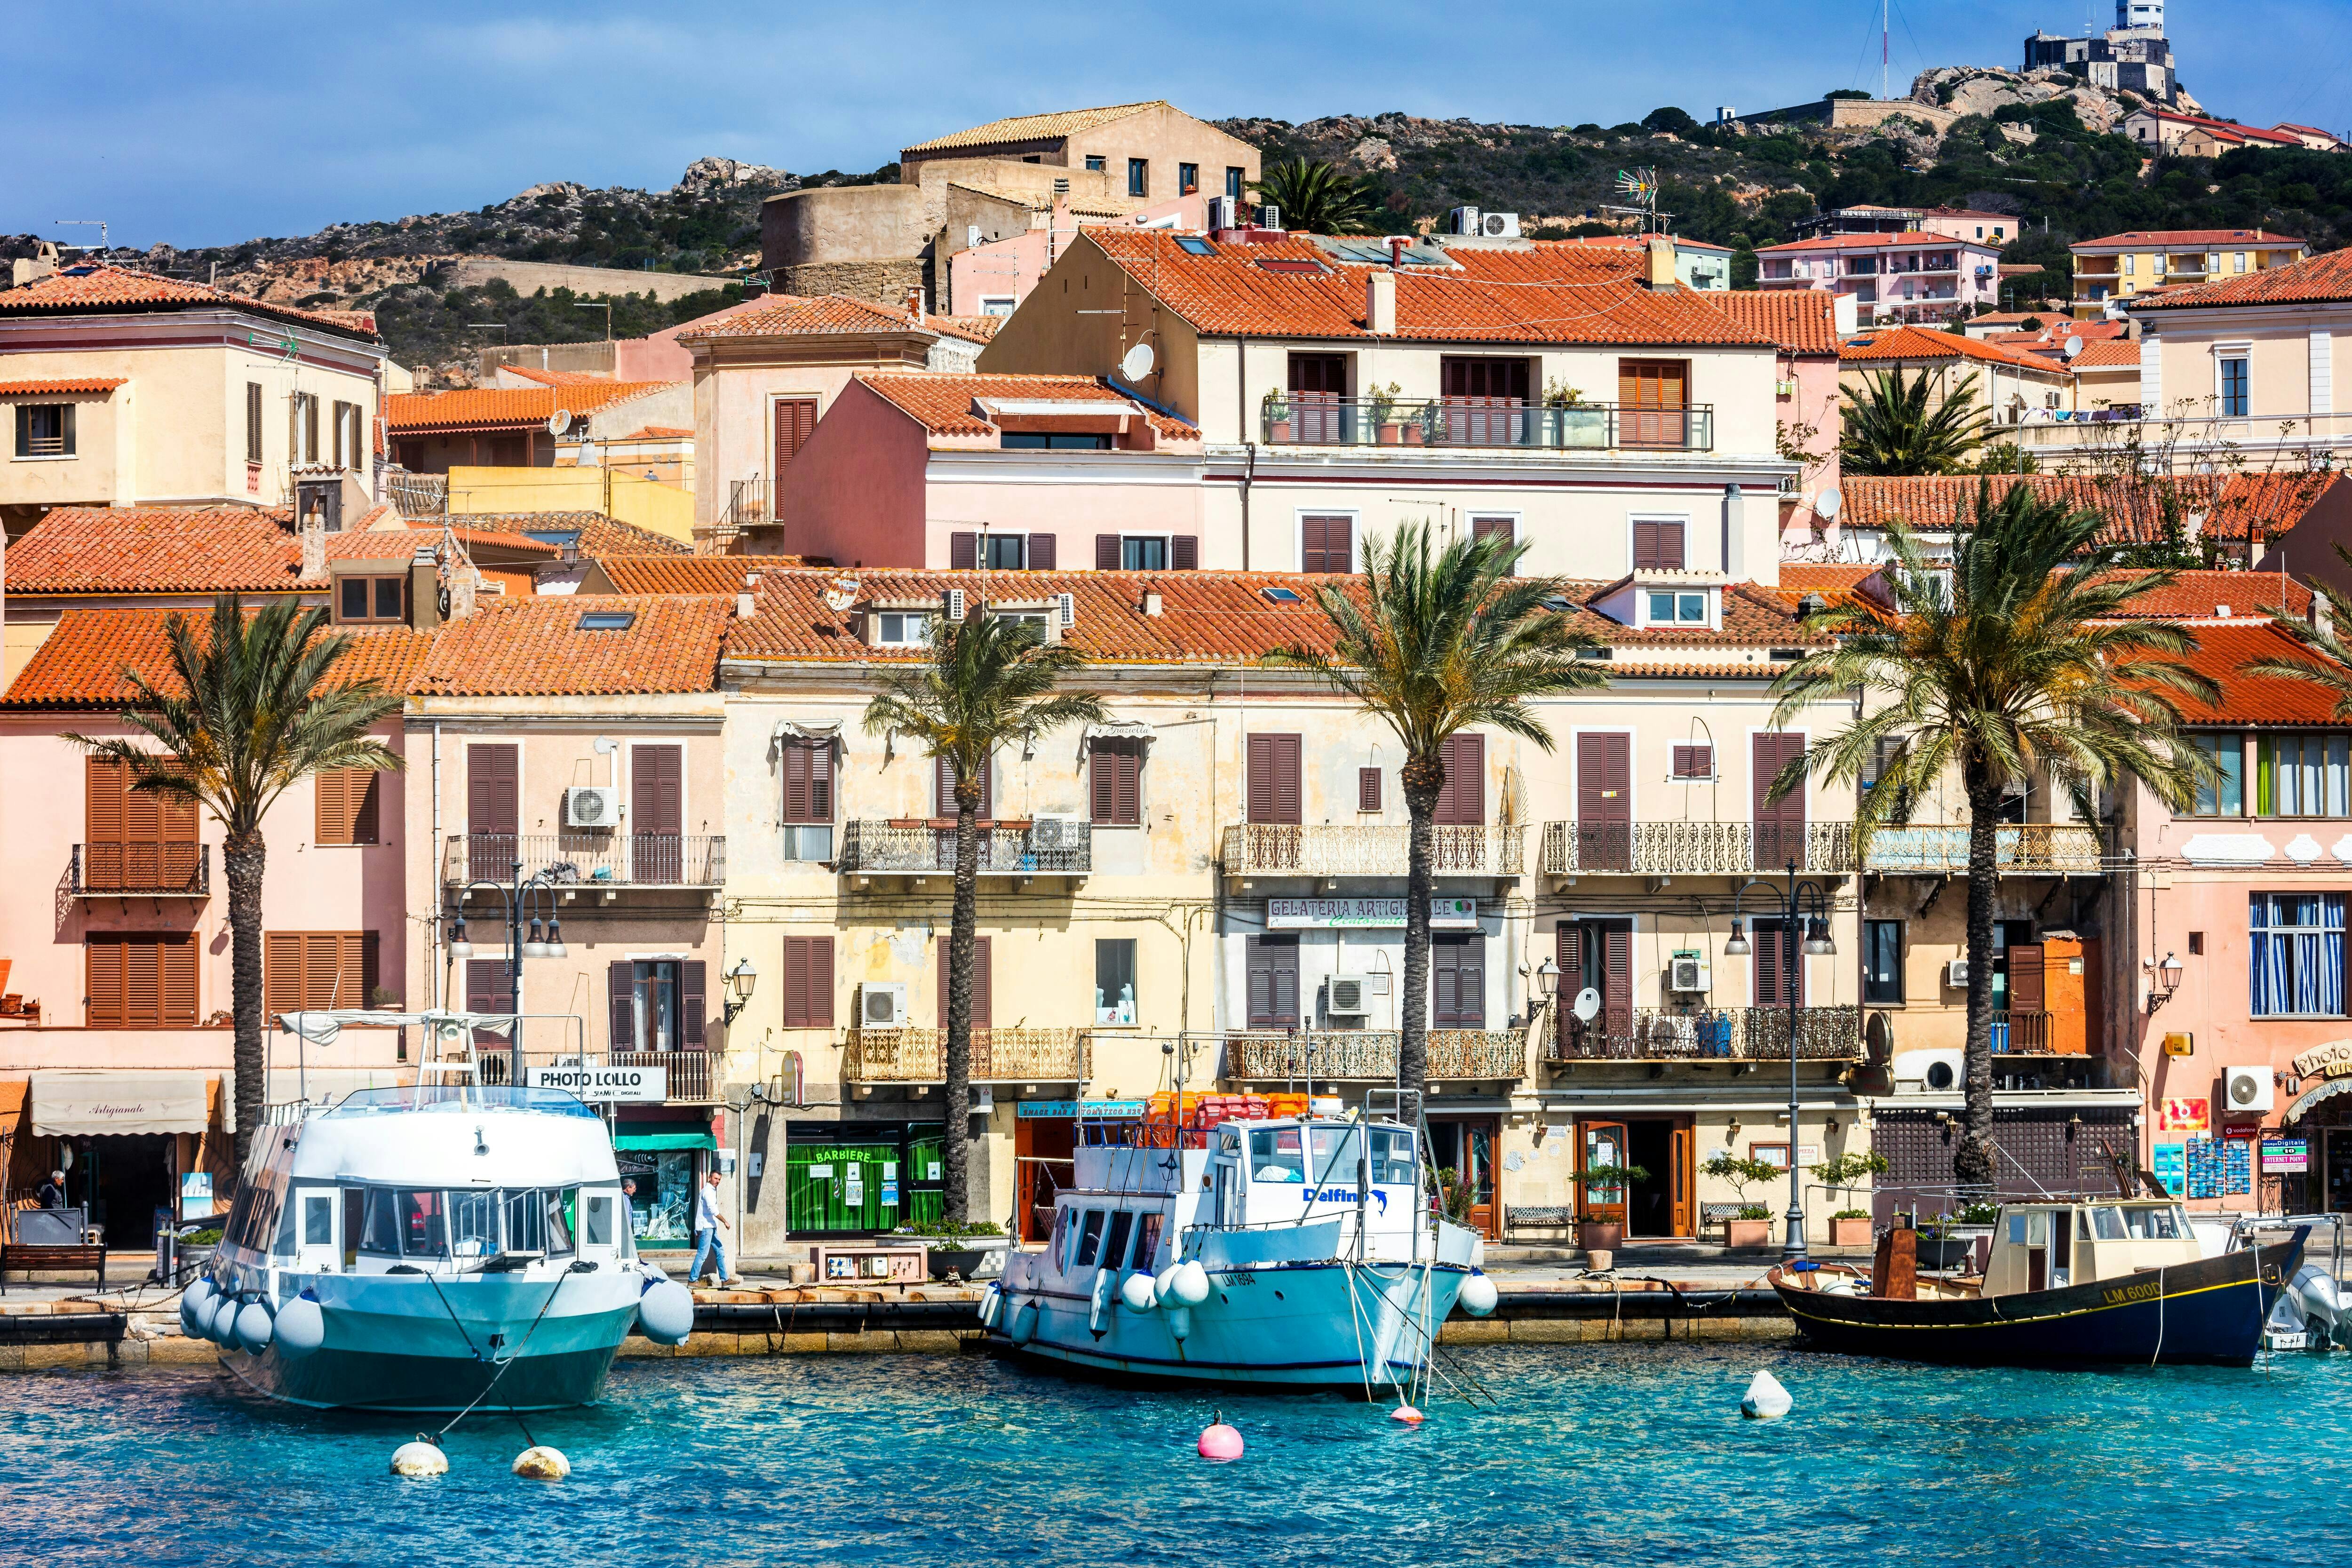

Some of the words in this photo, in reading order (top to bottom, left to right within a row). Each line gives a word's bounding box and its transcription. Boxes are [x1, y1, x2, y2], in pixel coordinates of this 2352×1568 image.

[1106, 724, 1149, 735] Graziella
[1271, 900, 1351, 918] GELATERIA
[1356, 900, 1451, 917] ARTIGILE
[1329, 915, 1406, 927] Centogusti
[2297, 1044, 2351, 1075] Photo
[541, 1073, 591, 1086] PHOTO
[596, 1073, 641, 1086] LOLLO
[88, 1103, 146, 1118] Artigianato
[816, 1150, 870, 1163] BARBIERE
[1221, 1274, 1237, 1287] LM
[1234, 1273, 1256, 1286] 1694
[2103, 1289, 2126, 1304] LM
